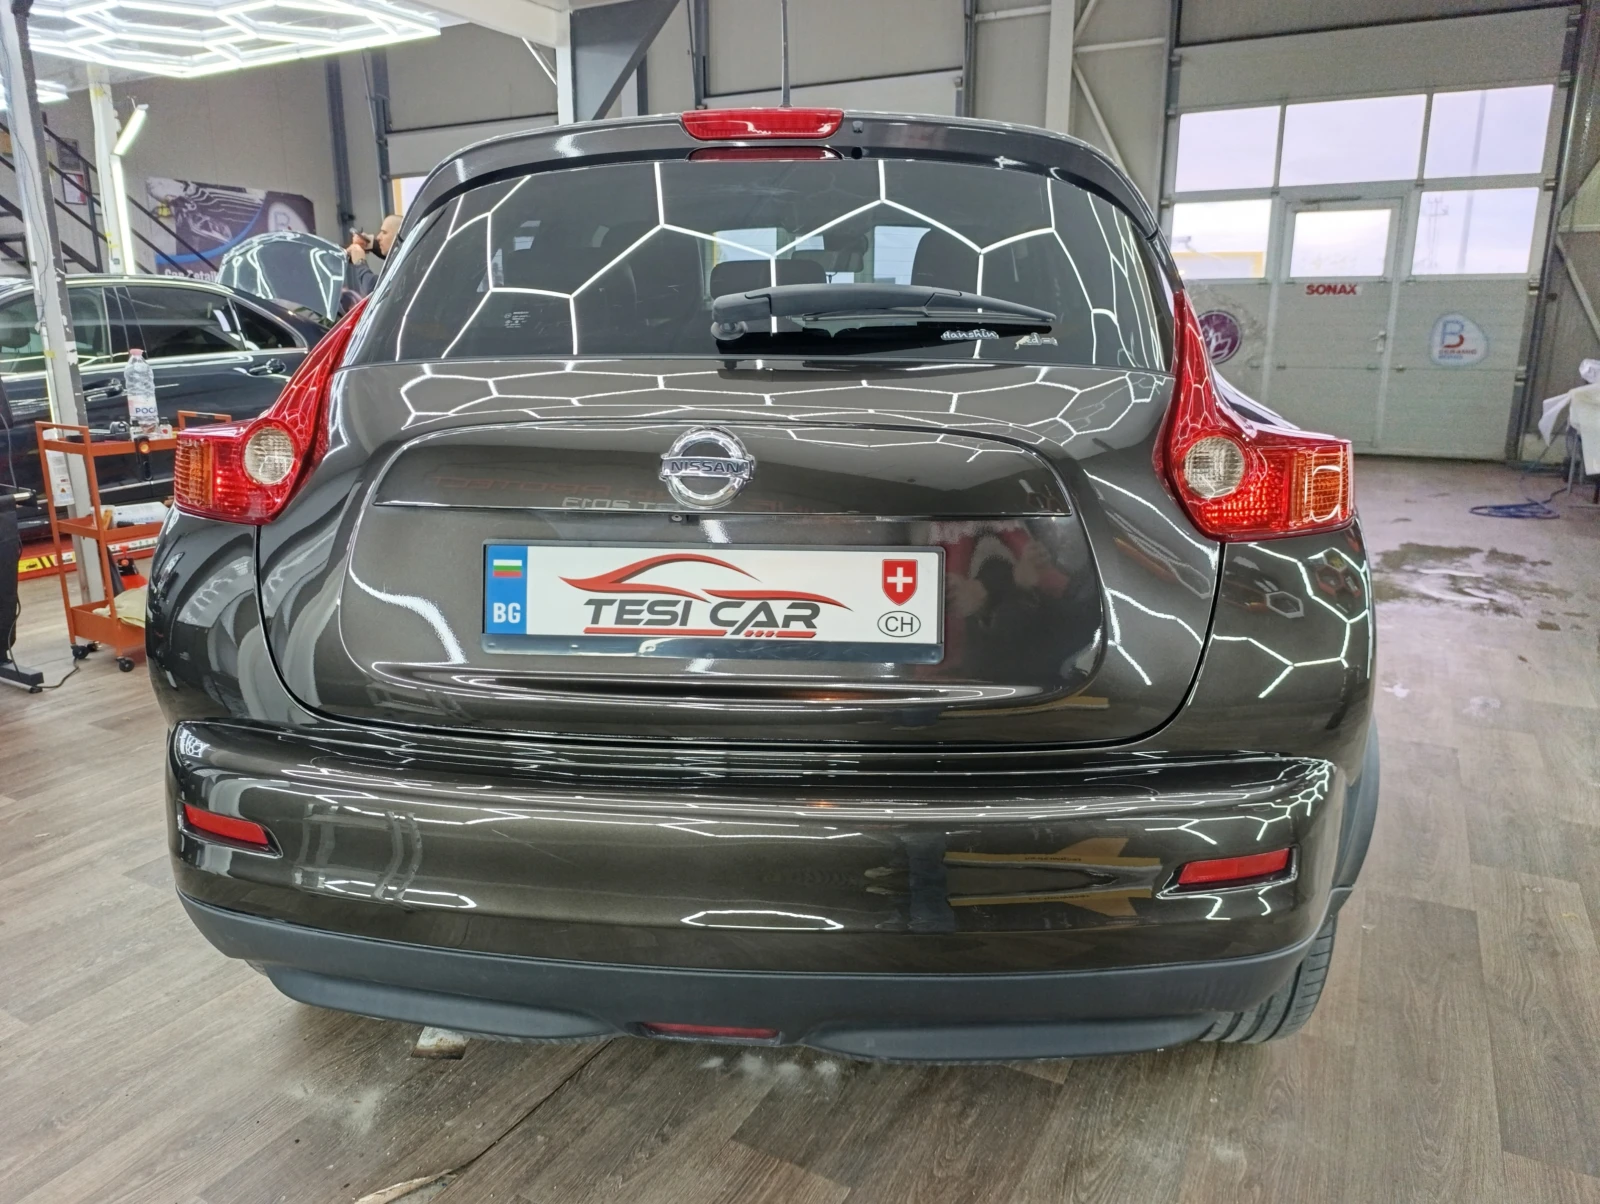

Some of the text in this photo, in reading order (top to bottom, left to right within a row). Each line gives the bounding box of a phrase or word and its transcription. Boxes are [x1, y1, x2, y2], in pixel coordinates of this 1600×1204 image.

[1305, 283, 1357, 296] SONAX
[671, 461, 739, 473] NISSAN
[493, 602, 521, 624] BG
[583, 598, 821, 635] TESI CAR
[884, 615, 914, 633] CH
